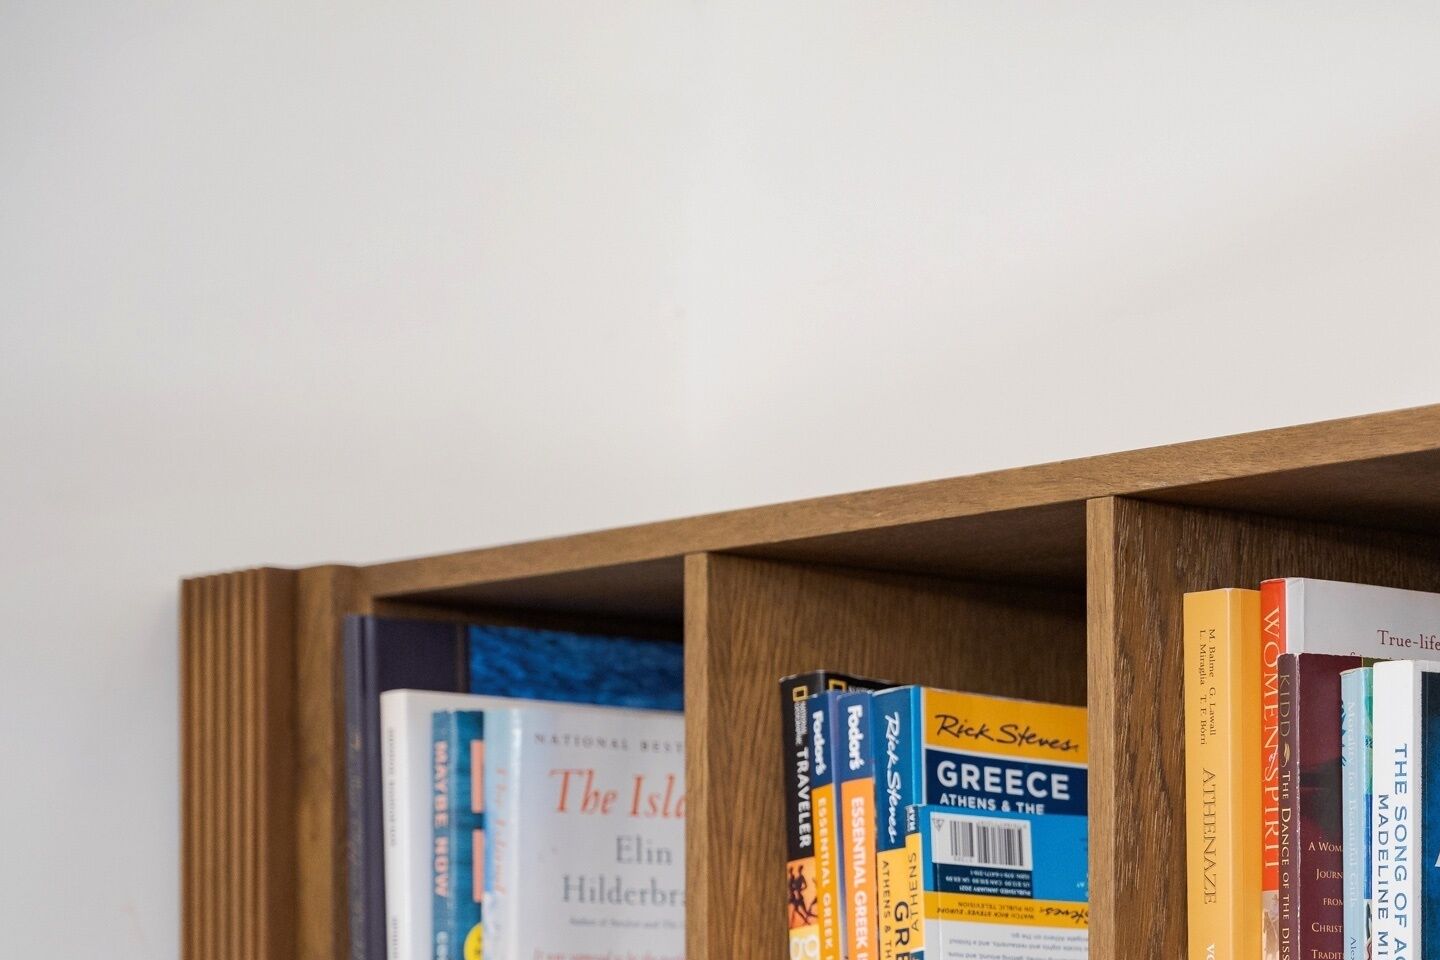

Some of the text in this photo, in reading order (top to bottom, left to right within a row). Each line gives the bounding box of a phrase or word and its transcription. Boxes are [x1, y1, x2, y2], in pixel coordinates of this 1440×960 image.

[1200, 630, 1206, 640] L.
[1209, 629, 1216, 642] M.
[1198, 644, 1206, 686] Miraglia
[1200, 694, 1206, 704] T.
[1209, 687, 1216, 699] G.
[1280, 674, 1290, 737] KIDD
[812, 710, 827, 775] Fodor's
[848, 705, 864, 771] Fodor's
[934, 714, 1075, 751] Rick Steves
[548, 767, 618, 816] The
[885, 712, 902, 844] Rick Steves
[936, 760, 1070, 800] GREECE
[1394, 743, 1408, 796] THE
[435, 741, 449, 898] MAYBE NOW
[796, 747, 812, 848] TRAVELER
[939, 792, 1046, 816] ATHENS & THE
[616, 834, 673, 866] Elin
[818, 798, 830, 887] ESSENTIAL
[851, 796, 868, 888] ESSENTIAL
[1202, 767, 1217, 905] ATHENAZE
[1308, 842, 1316, 851] A
[1378, 794, 1390, 920] MADELINE
[1394, 804, 1408, 882] SONG
[882, 860, 891, 919] ATHENS
[908, 852, 920, 932] ATHENS
[958, 902, 996, 910] TELEVISION
[1394, 892, 1408, 928] OF
[823, 893, 833, 949] GREEK
[854, 891, 868, 949] GREEK
[884, 925, 892, 934] &
